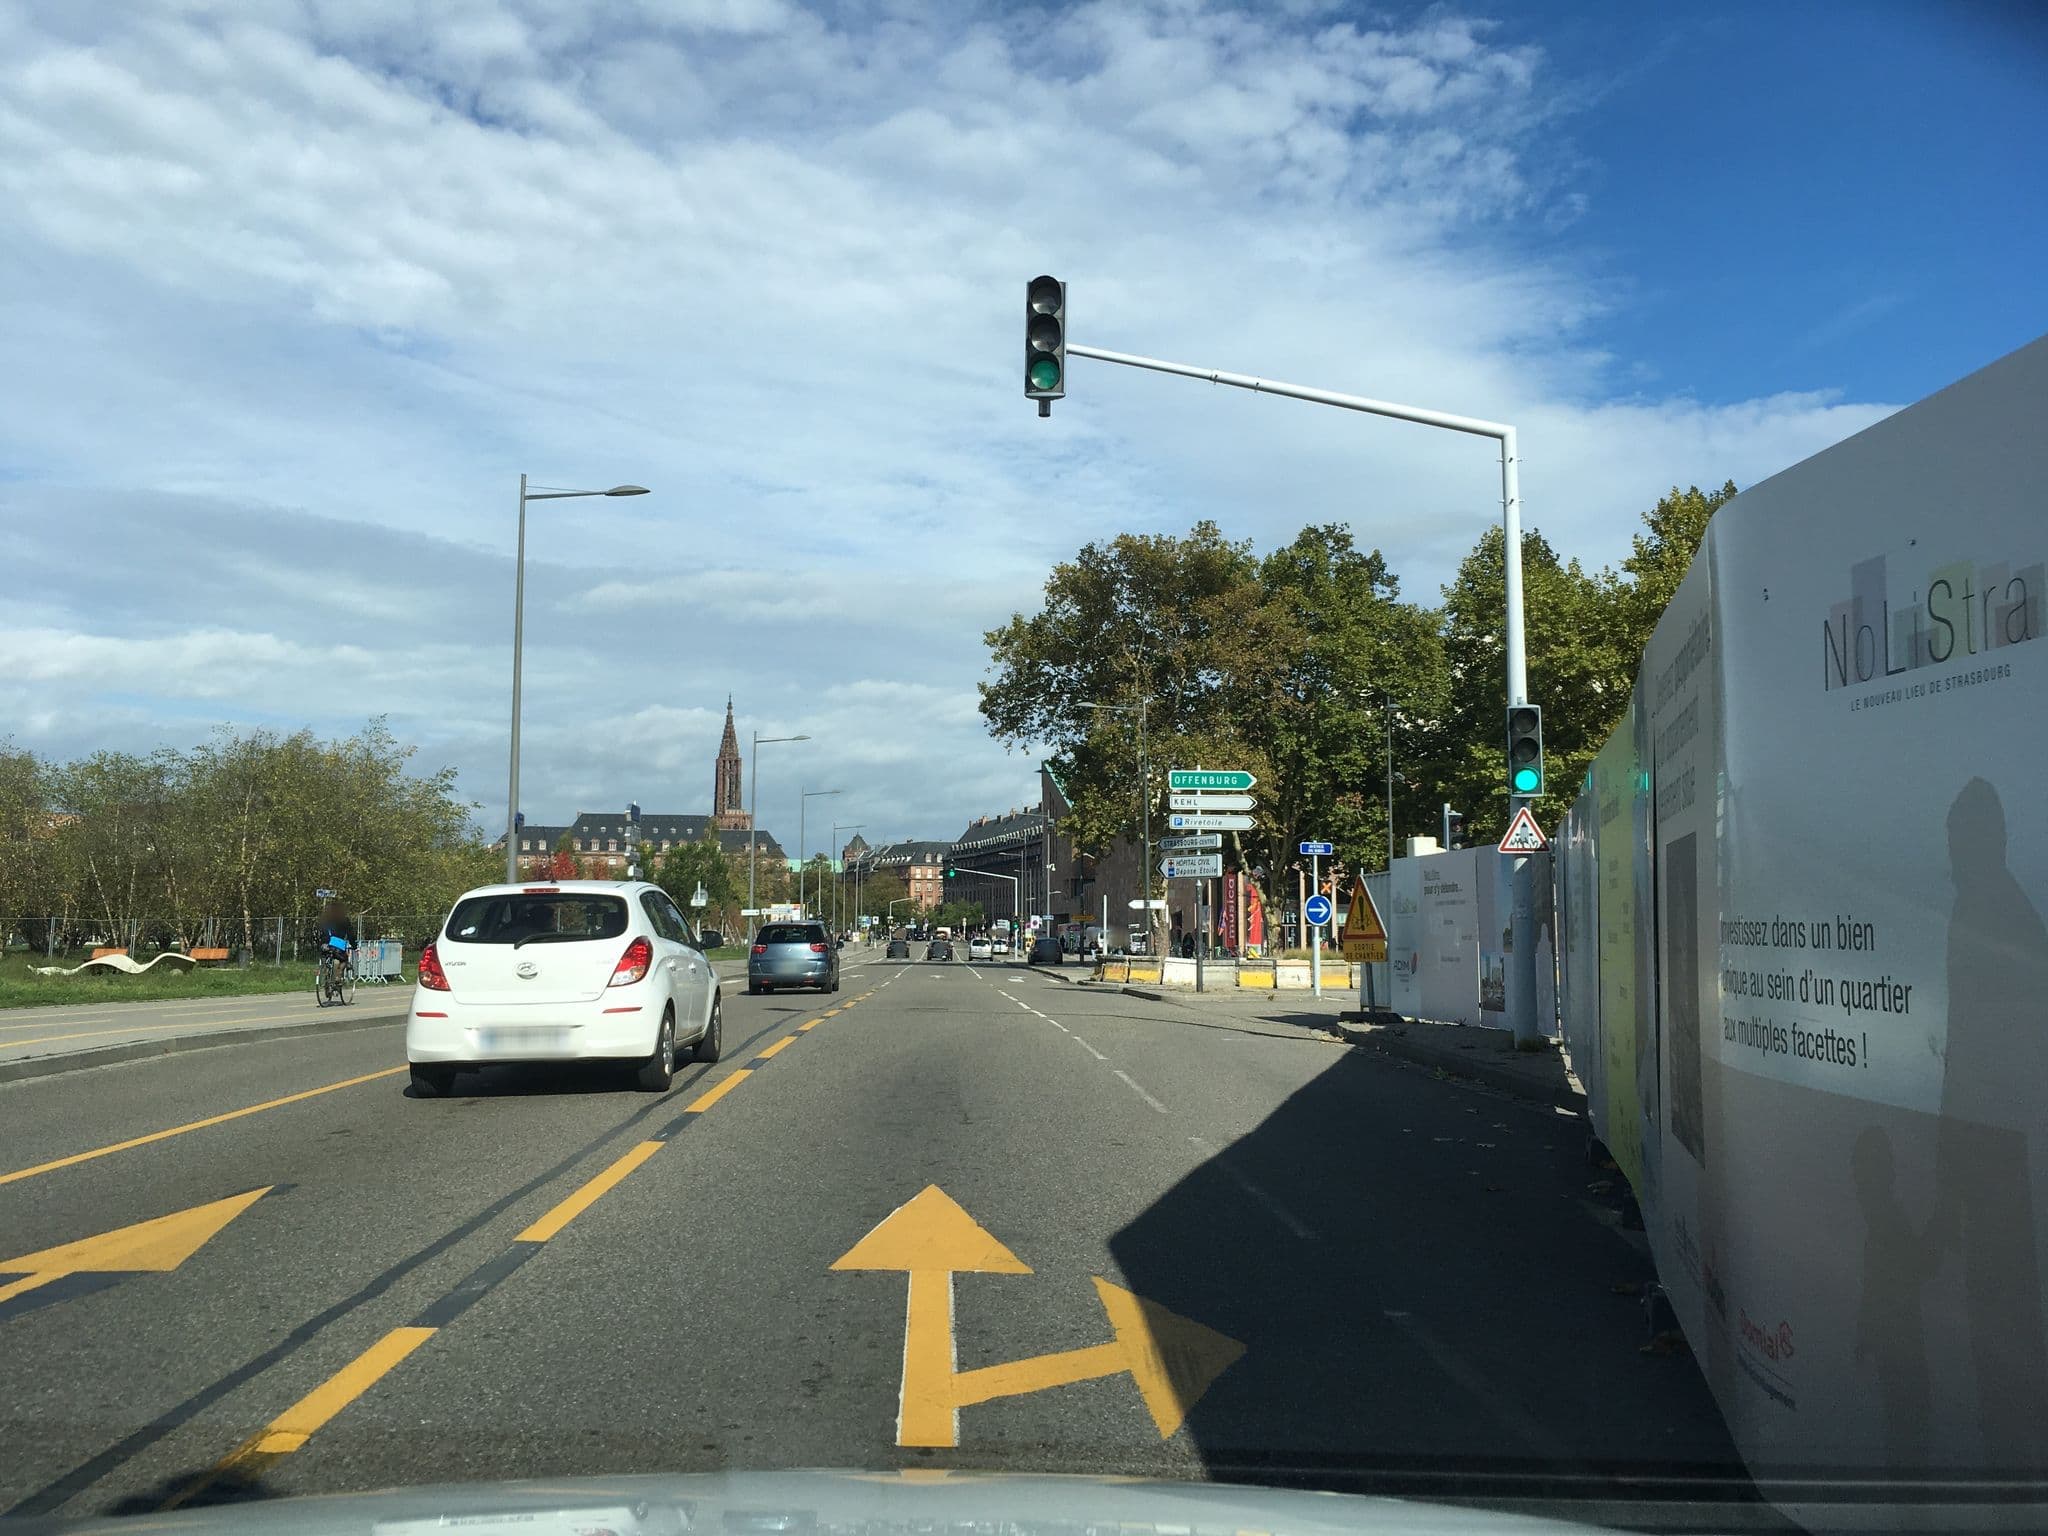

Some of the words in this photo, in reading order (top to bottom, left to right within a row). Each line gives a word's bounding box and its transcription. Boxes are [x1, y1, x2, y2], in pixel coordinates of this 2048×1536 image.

[1823, 577, 2032, 691] NoLiStra
[1850, 699, 1860, 712] LE
[1863, 687, 1902, 709] NOUVEAU
[1905, 683, 1926, 700] LIEU
[1929, 679, 1941, 694] DE
[1945, 663, 2011, 692] STRASBOURG
[1174, 776, 1238, 785] OFFENBURG
[1174, 798, 1198, 806] KEHL
[1184, 818, 1223, 826] Rivetoile
[1228, 879, 1236, 939] musica
[1352, 943, 1376, 951] SORTIE
[1771, 914, 1806, 949] dans
[1811, 921, 1831, 949] un
[1837, 914, 1875, 951] bien
[1355, 951, 1384, 960] CHANTIER
[1750, 972, 1764, 997] au
[1767, 968, 1795, 1001] sein
[1799, 969, 1834, 1006] d'un
[1840, 975, 1912, 1016] quartier
[1724, 1015, 1736, 1040] aux
[1738, 1016, 1788, 1057] multiples
[1791, 1021, 1857, 1067] facettes
